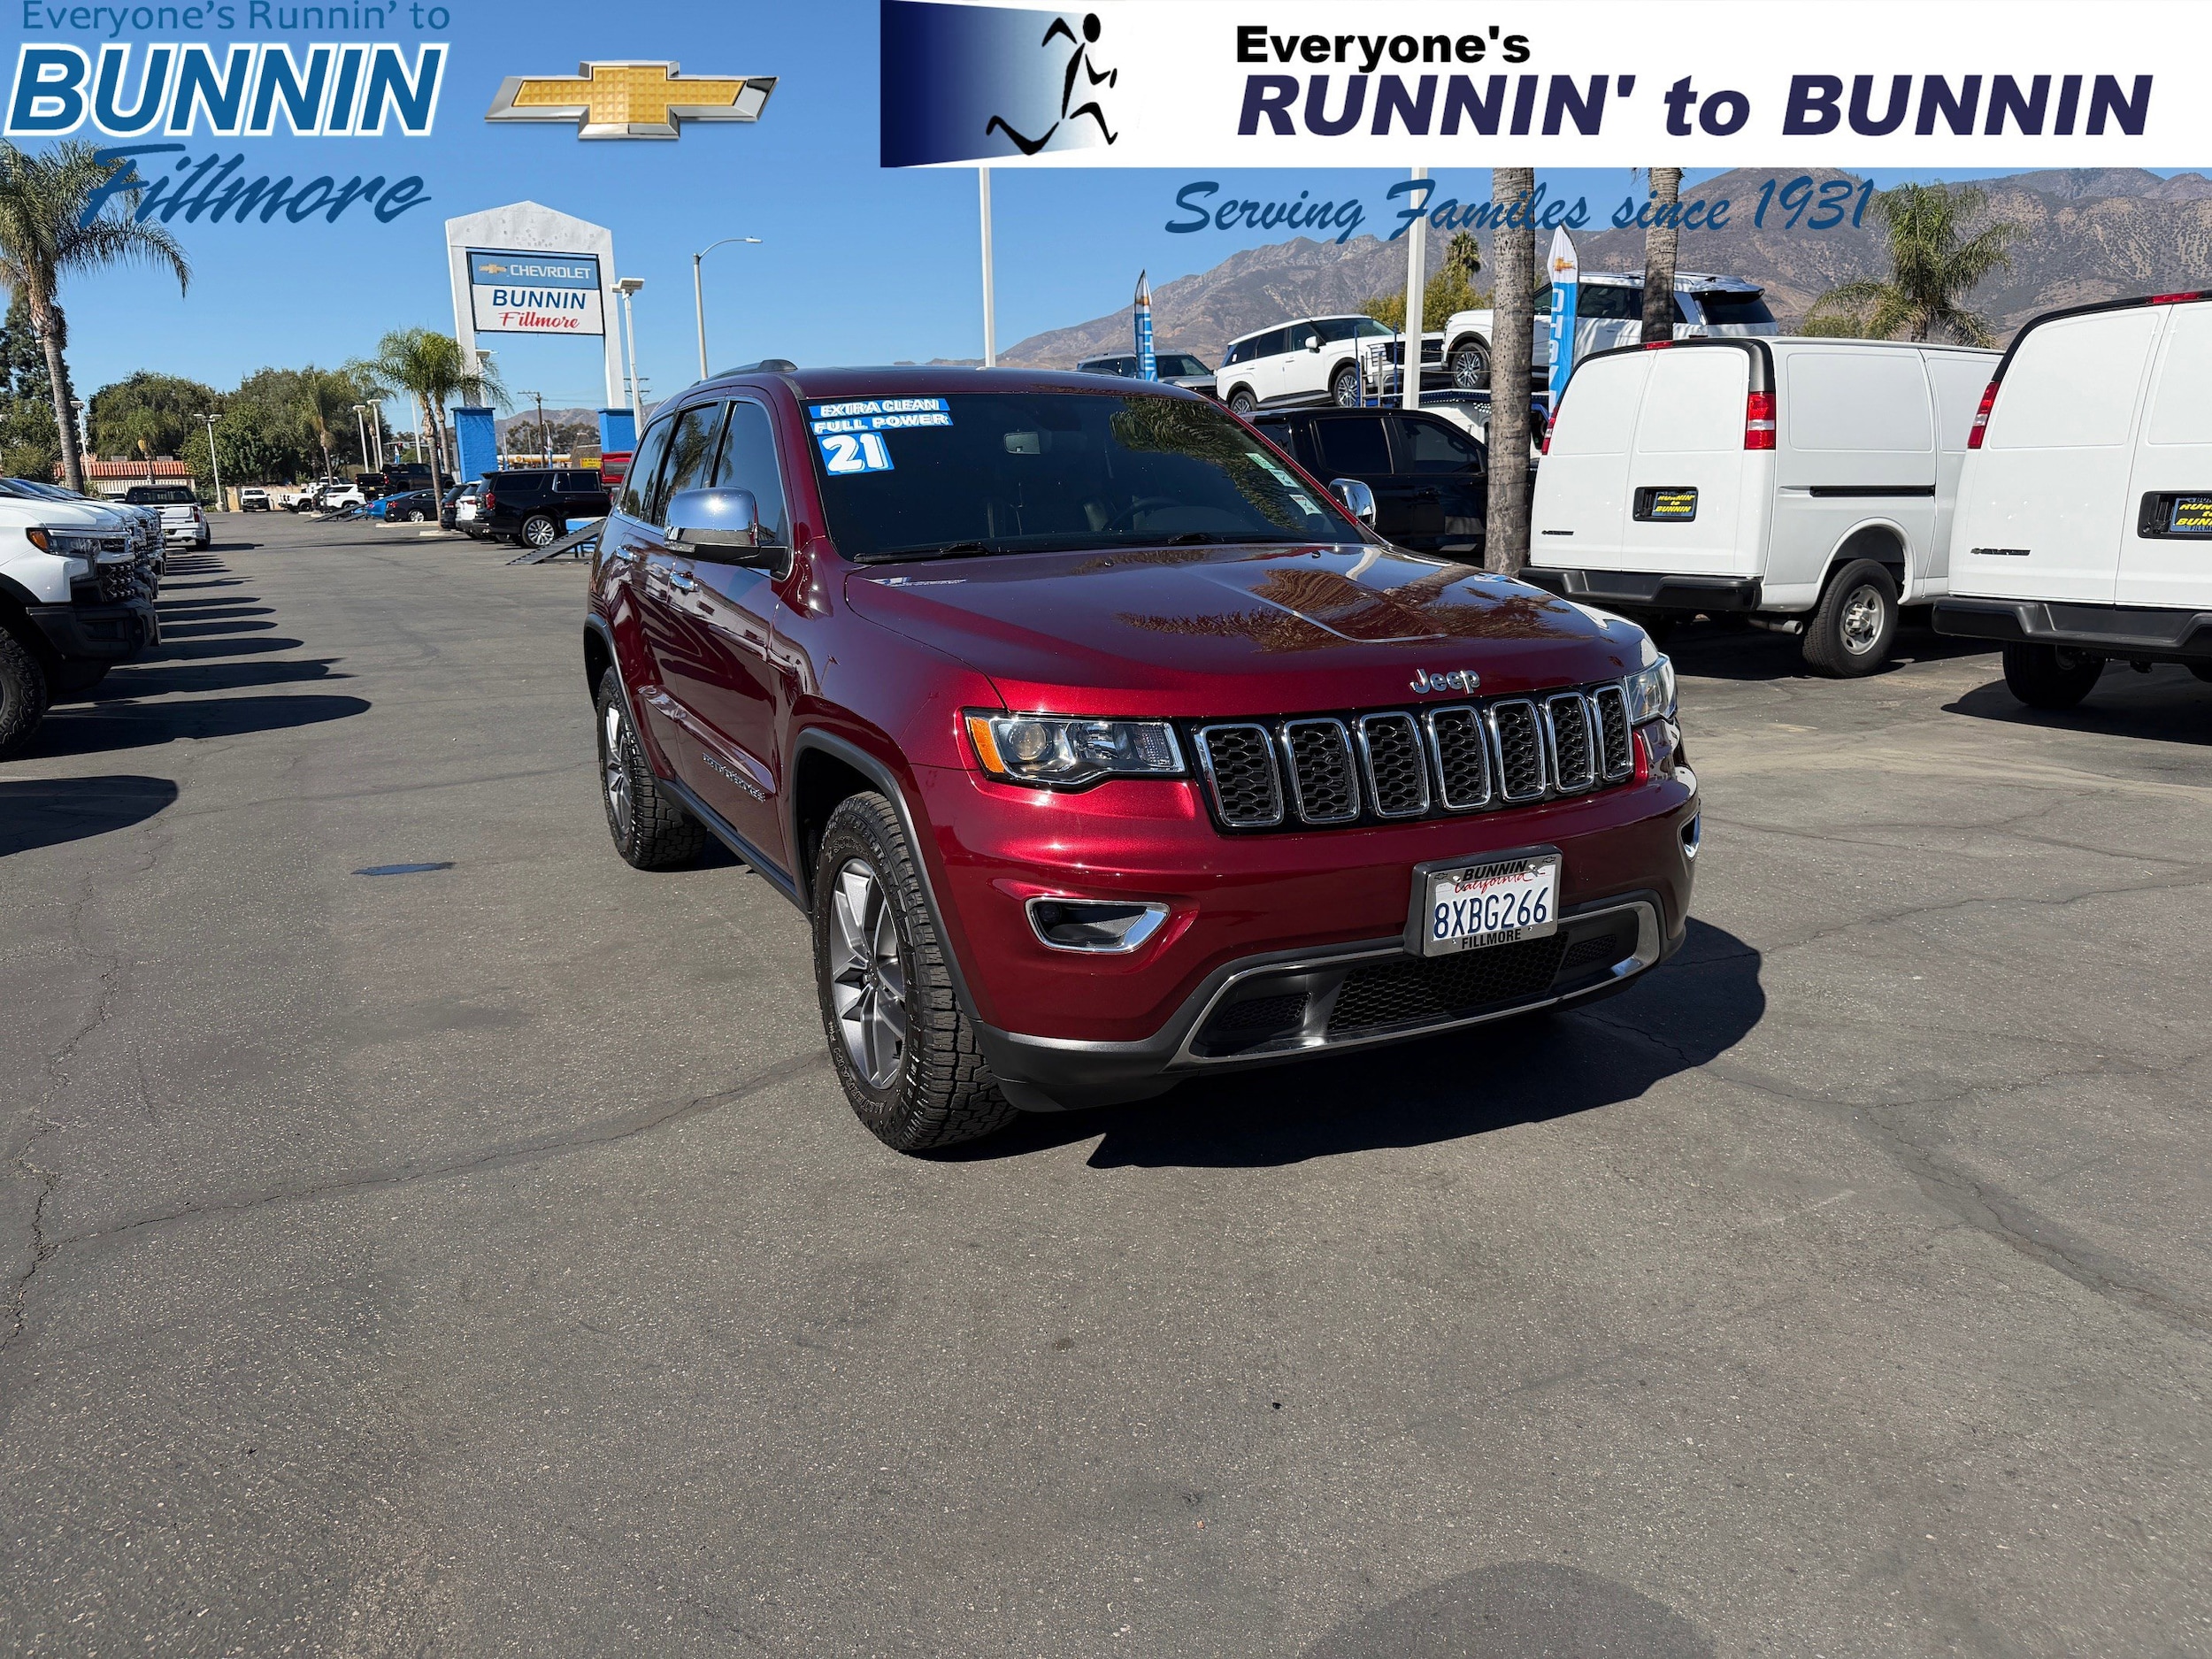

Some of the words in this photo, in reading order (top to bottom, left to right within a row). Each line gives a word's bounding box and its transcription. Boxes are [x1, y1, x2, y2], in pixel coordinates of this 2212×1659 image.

[510, 265, 591, 279] CHEVROLET
[493, 289, 586, 310] BUNNIN
[498, 311, 580, 328] Fillmore
[820, 401, 881, 417] EXTRA
[882, 399, 940, 412] CLEAN
[814, 419, 868, 434] FULL
[872, 414, 949, 428] POWER
[822, 433, 889, 472] 21
[1409, 668, 1480, 695] Jeep
[1463, 860, 1528, 882] BUNNIN
[1433, 887, 1548, 939] 8XBG266
[1462, 929, 1522, 949] FILLMORE
